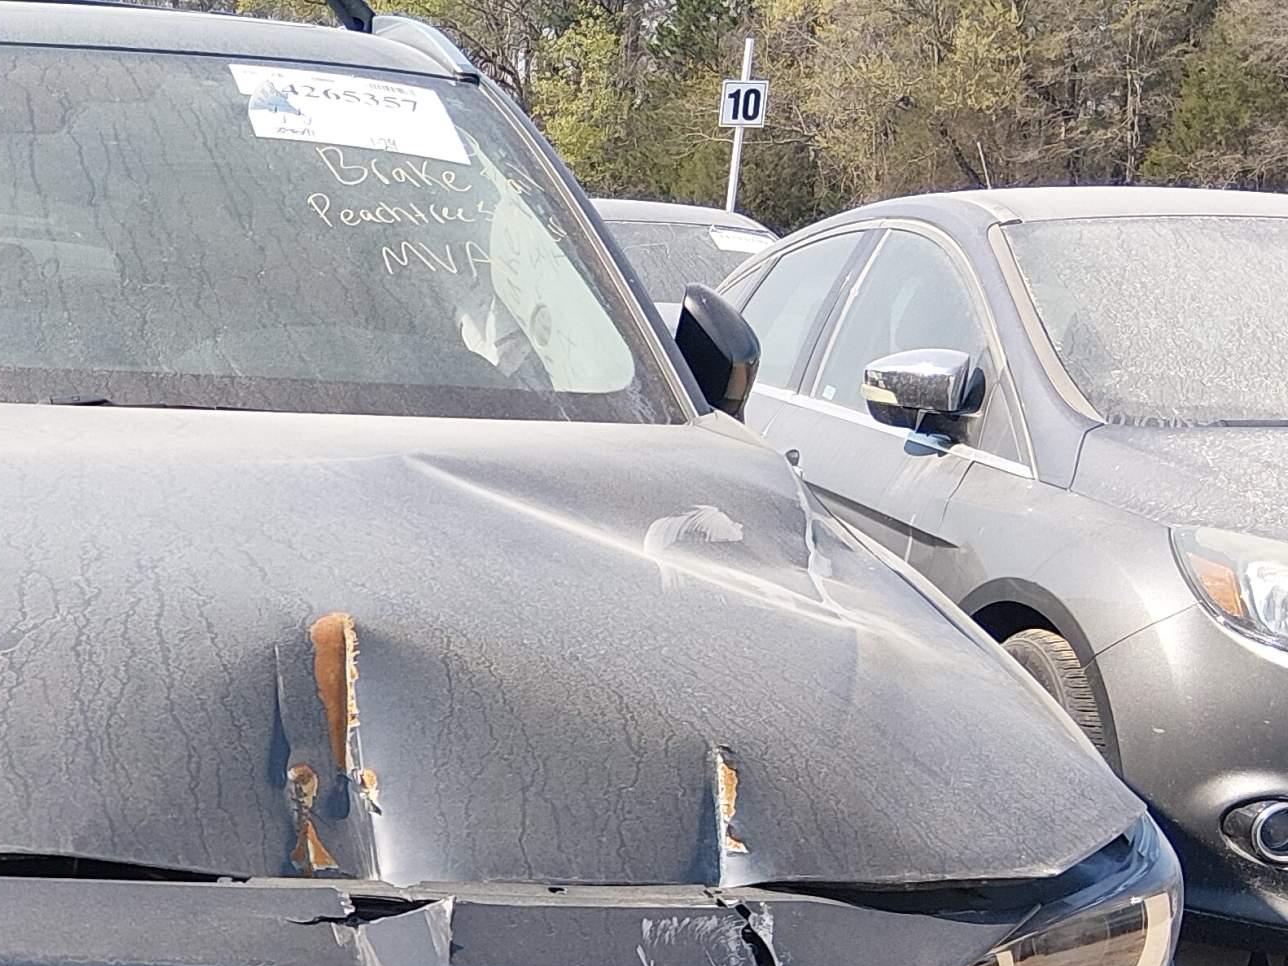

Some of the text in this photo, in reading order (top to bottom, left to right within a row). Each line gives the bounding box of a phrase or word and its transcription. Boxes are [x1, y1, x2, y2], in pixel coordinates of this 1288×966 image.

[727, 88, 762, 121] 10
[315, 146, 473, 192] Brake
[381, 240, 495, 280] MVA
